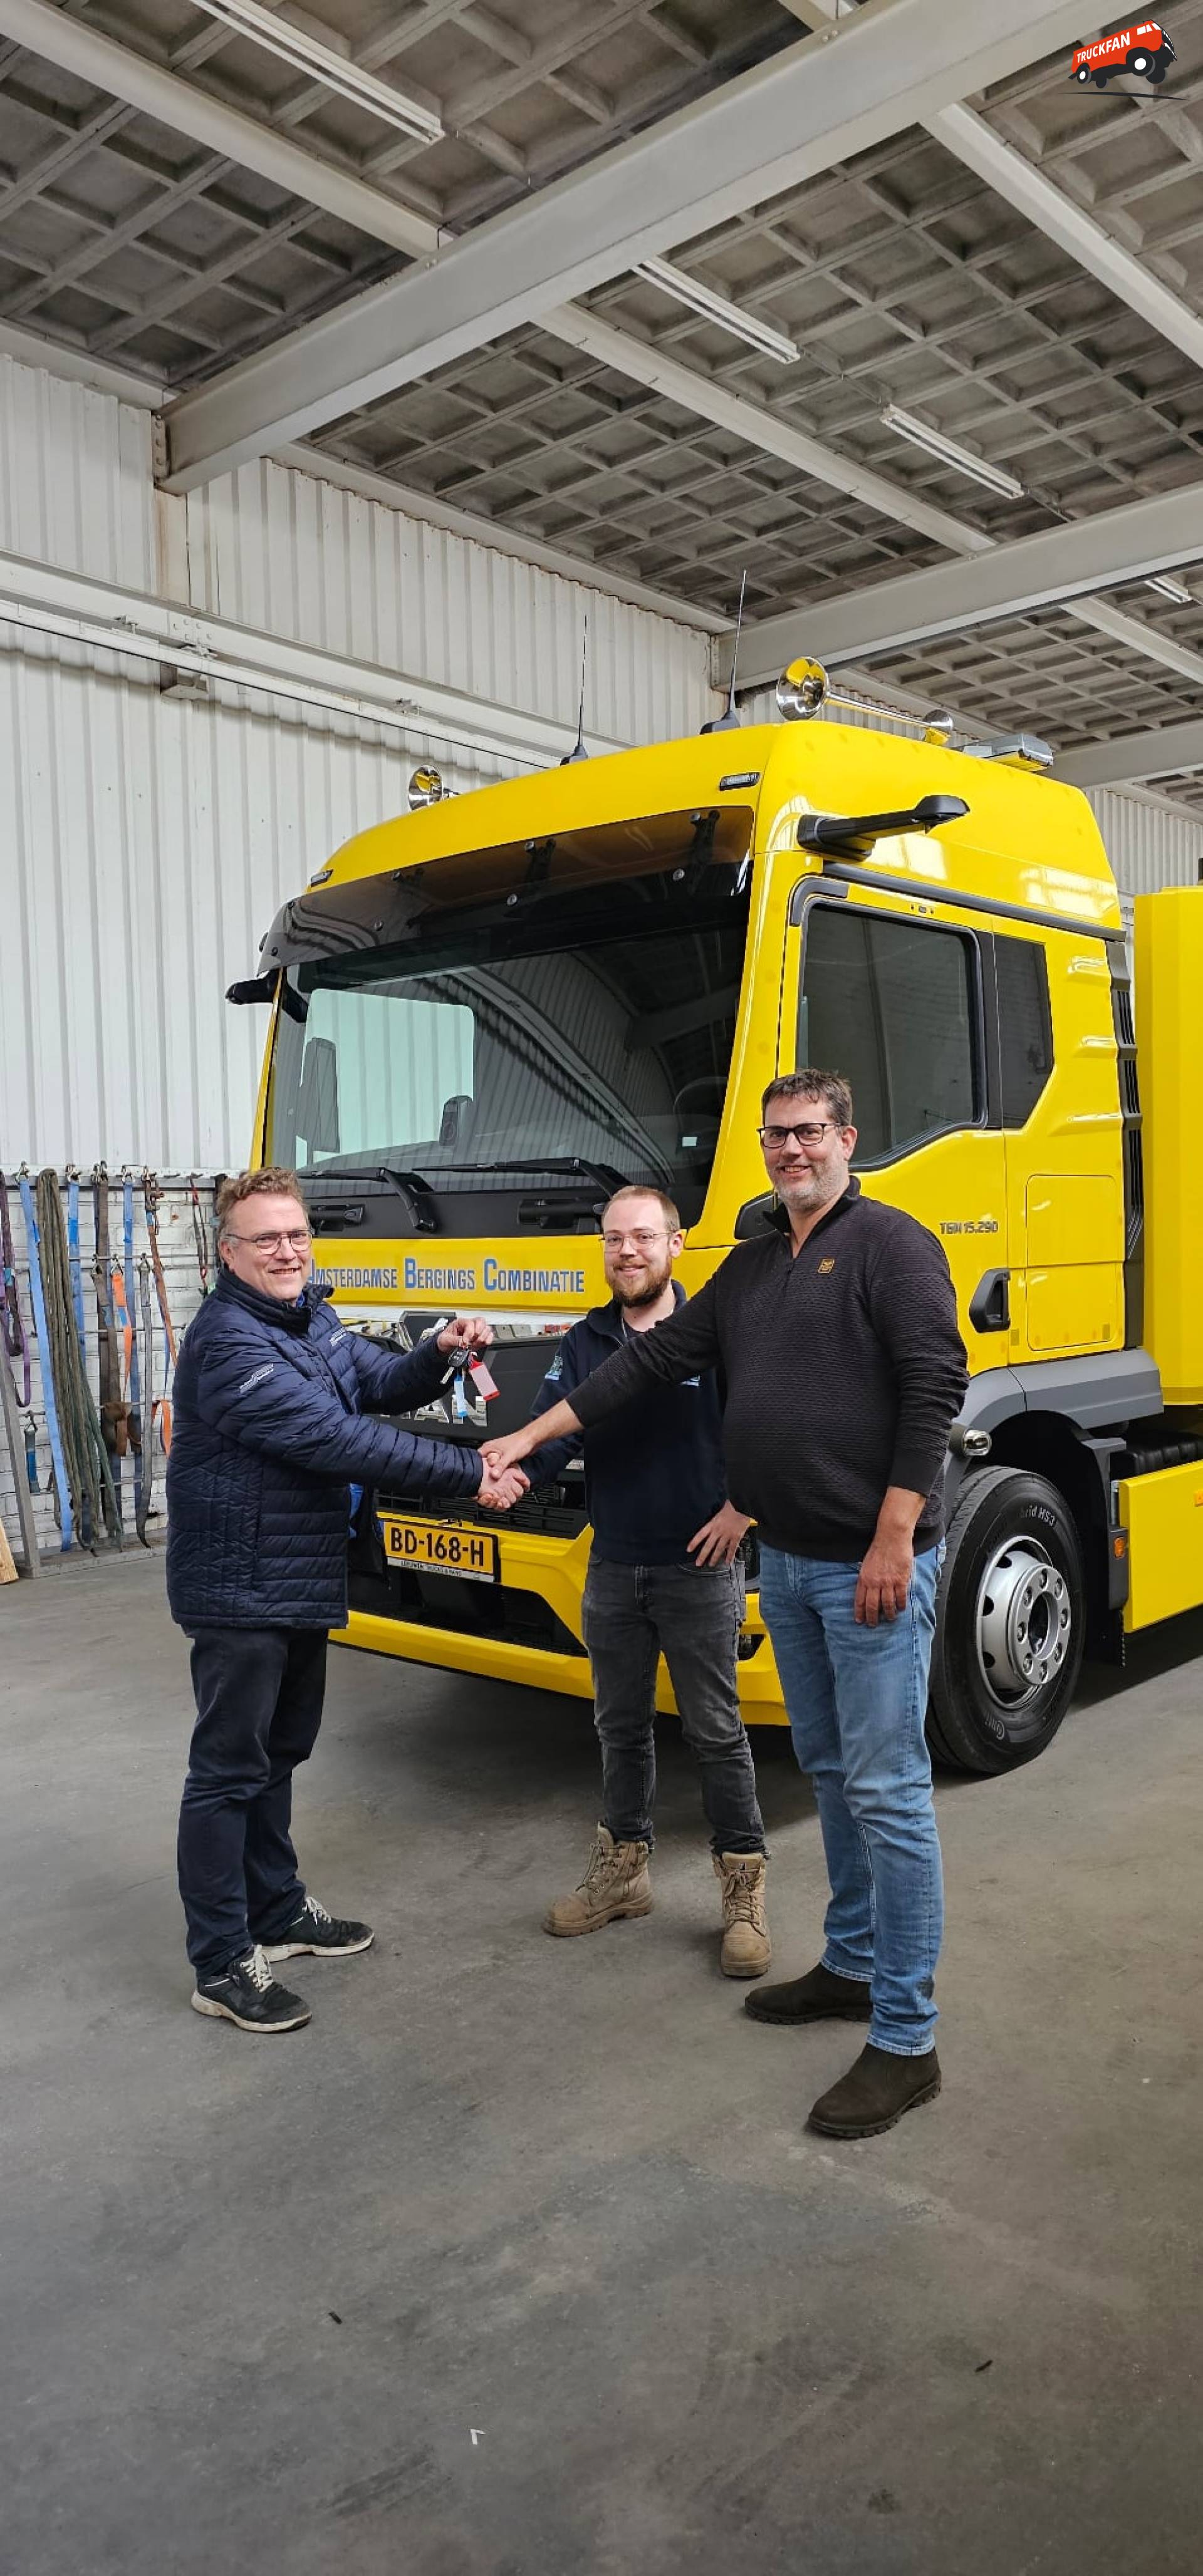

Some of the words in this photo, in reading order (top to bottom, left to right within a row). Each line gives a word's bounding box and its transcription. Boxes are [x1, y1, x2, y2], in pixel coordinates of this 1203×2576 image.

[405, 1258, 475, 1290] BERGINGS
[484, 1258, 585, 1293] COMBINATIE
[380, 1394, 487, 1427] AN
[1038, 1506, 1055, 1526] HS3
[391, 1528, 484, 1566] BD-168-H
